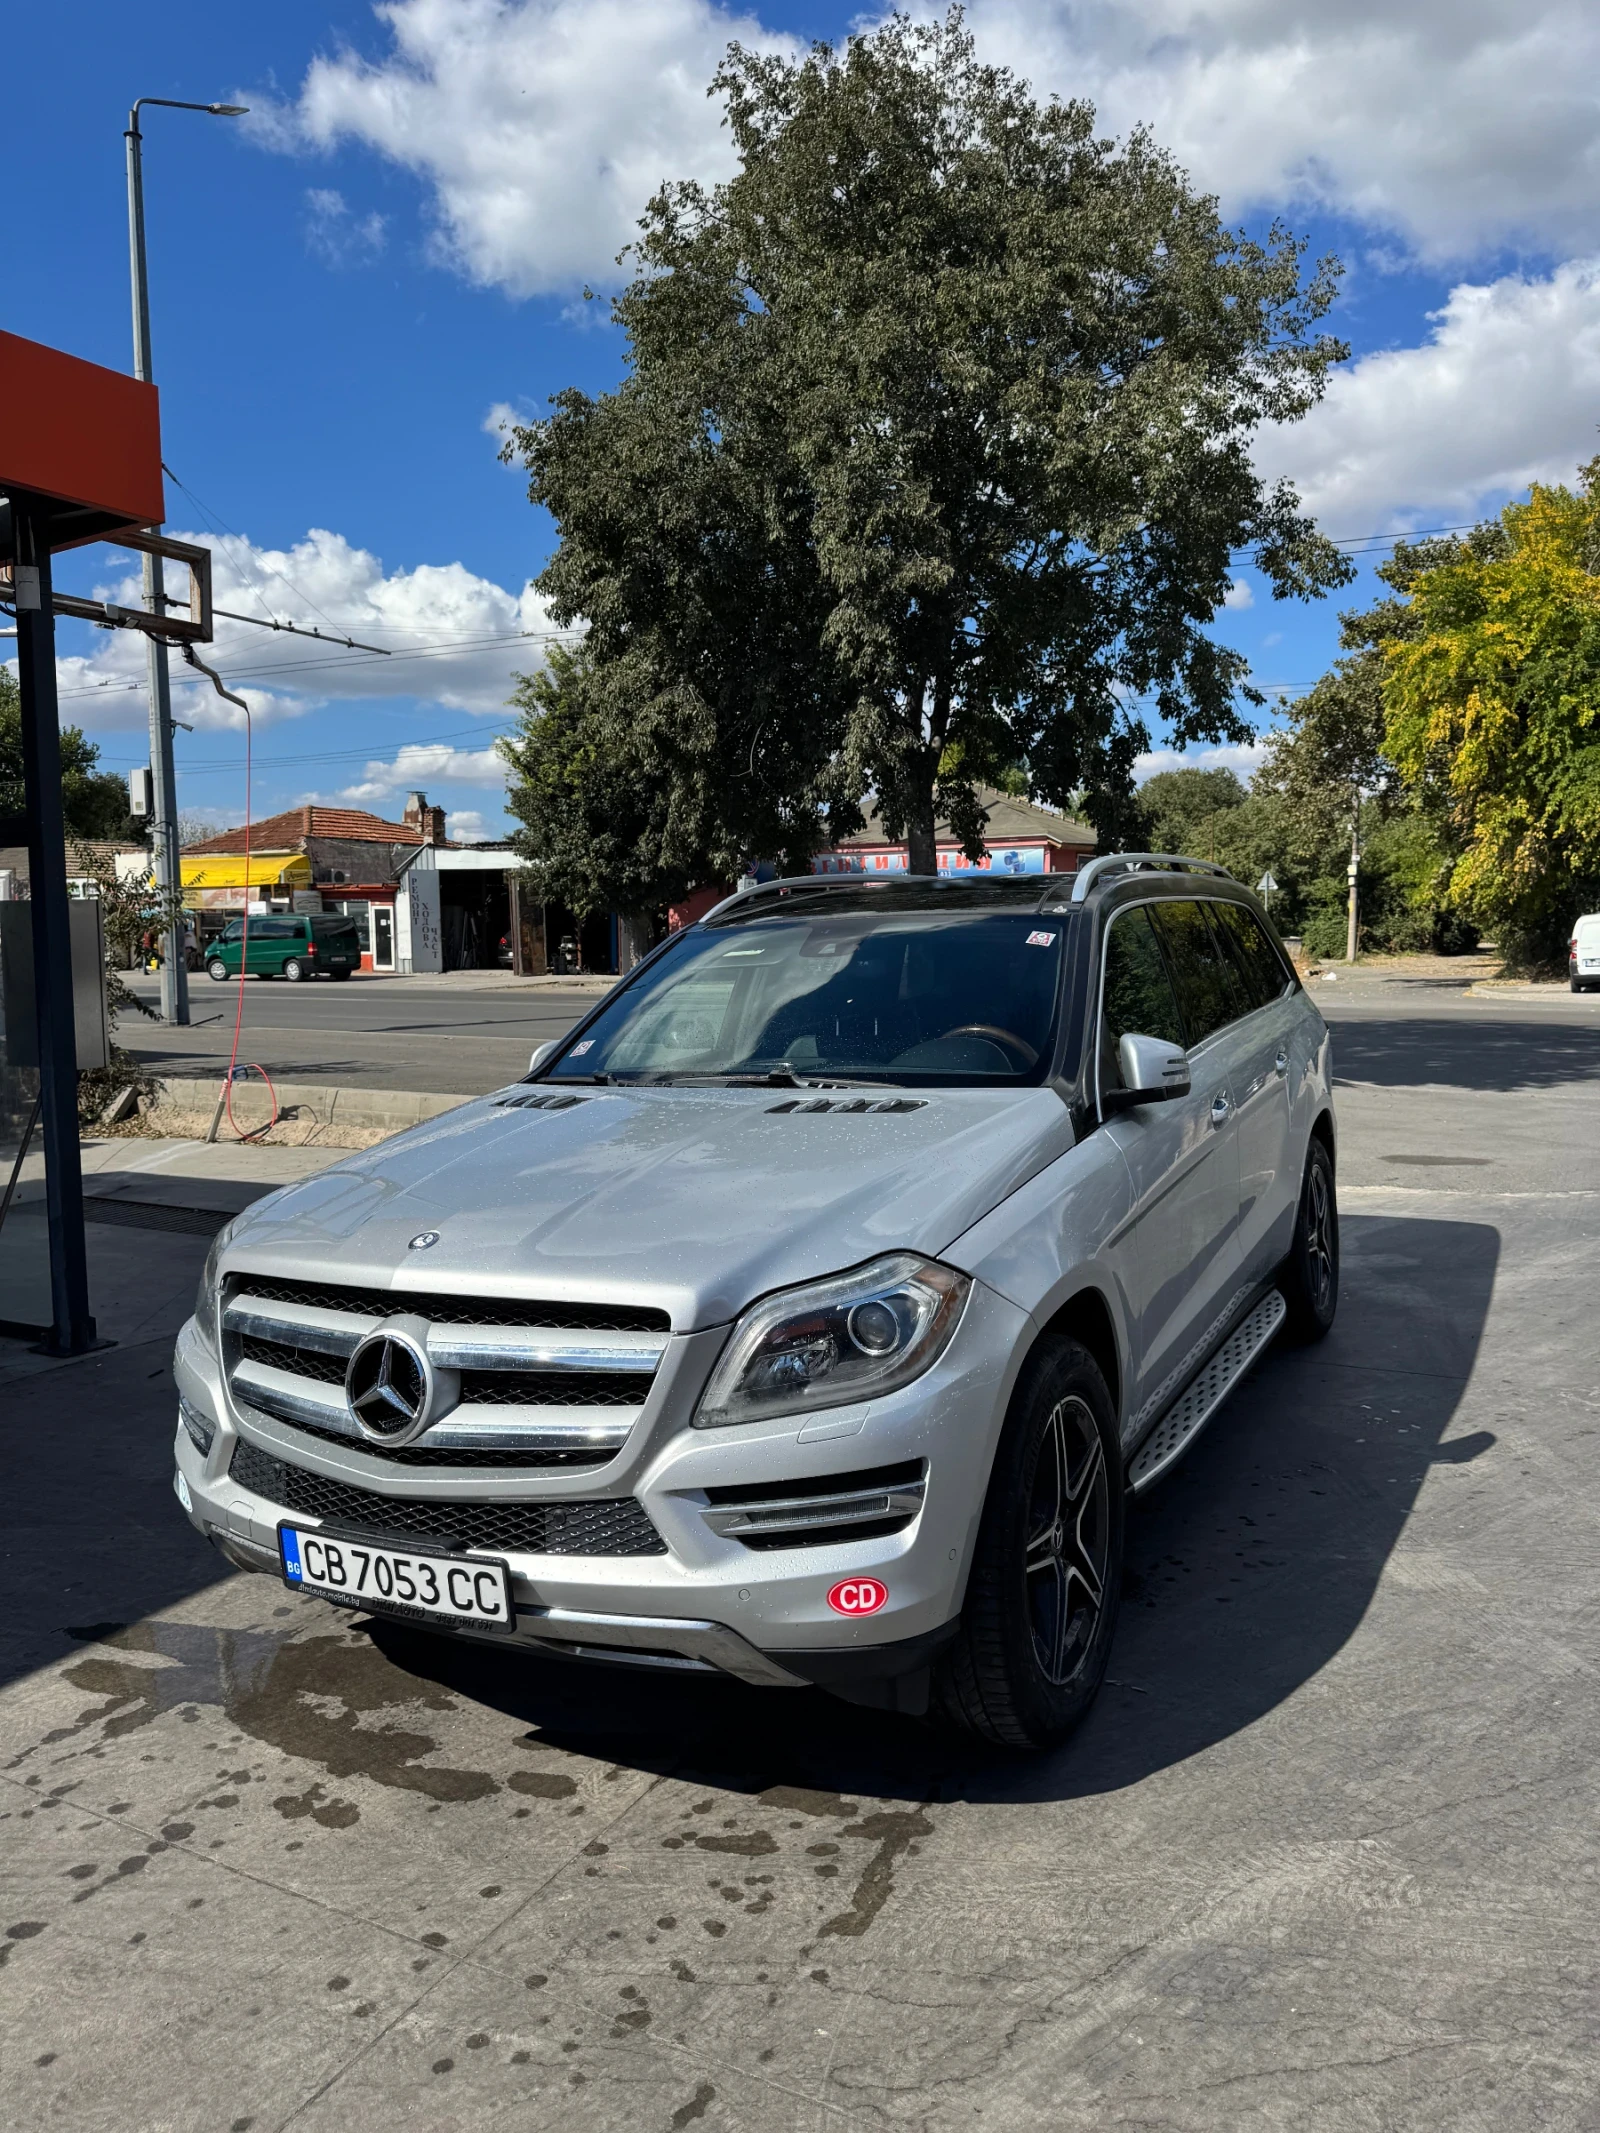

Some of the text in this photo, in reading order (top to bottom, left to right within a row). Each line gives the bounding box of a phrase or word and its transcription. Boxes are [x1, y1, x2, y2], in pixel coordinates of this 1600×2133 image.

[806, 855, 991, 874] ВЕНТИЛЦИЯ
[411, 878, 420, 925] РЕМОНТ
[421, 902, 430, 949] ХОДОВА
[431, 928, 439, 959] ЧАСТ
[286, 1560, 301, 1574] BG
[303, 1540, 500, 1615] CB 7053 CC
[840, 1584, 876, 1610] CD
